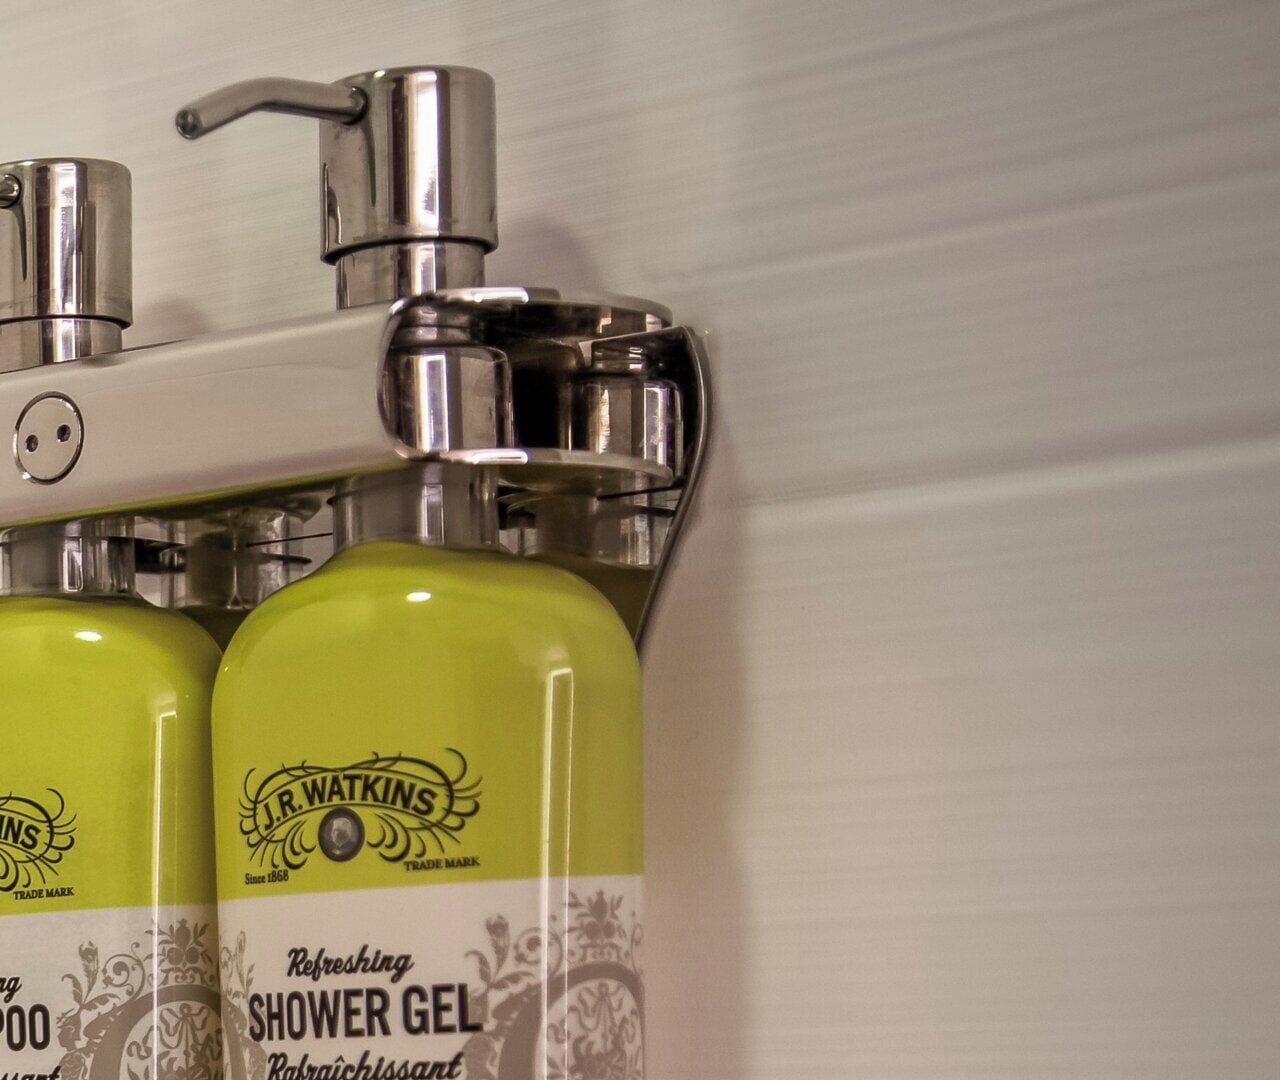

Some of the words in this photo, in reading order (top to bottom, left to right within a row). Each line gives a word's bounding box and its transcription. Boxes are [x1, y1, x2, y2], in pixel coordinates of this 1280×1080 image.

[263, 788, 303, 830] J.R.
[301, 773, 439, 816] WATKINS
[244, 872, 266, 885] Since
[267, 869, 289, 883] 1868
[403, 859, 442, 871] TRADE
[445, 856, 480, 869] MARK
[13, 889, 43, 900] TRADE
[45, 887, 74, 897] MARK
[287, 944, 415, 983] Refreshing
[248, 987, 391, 1042] SHOWER
[402, 982, 483, 1035] GEL
